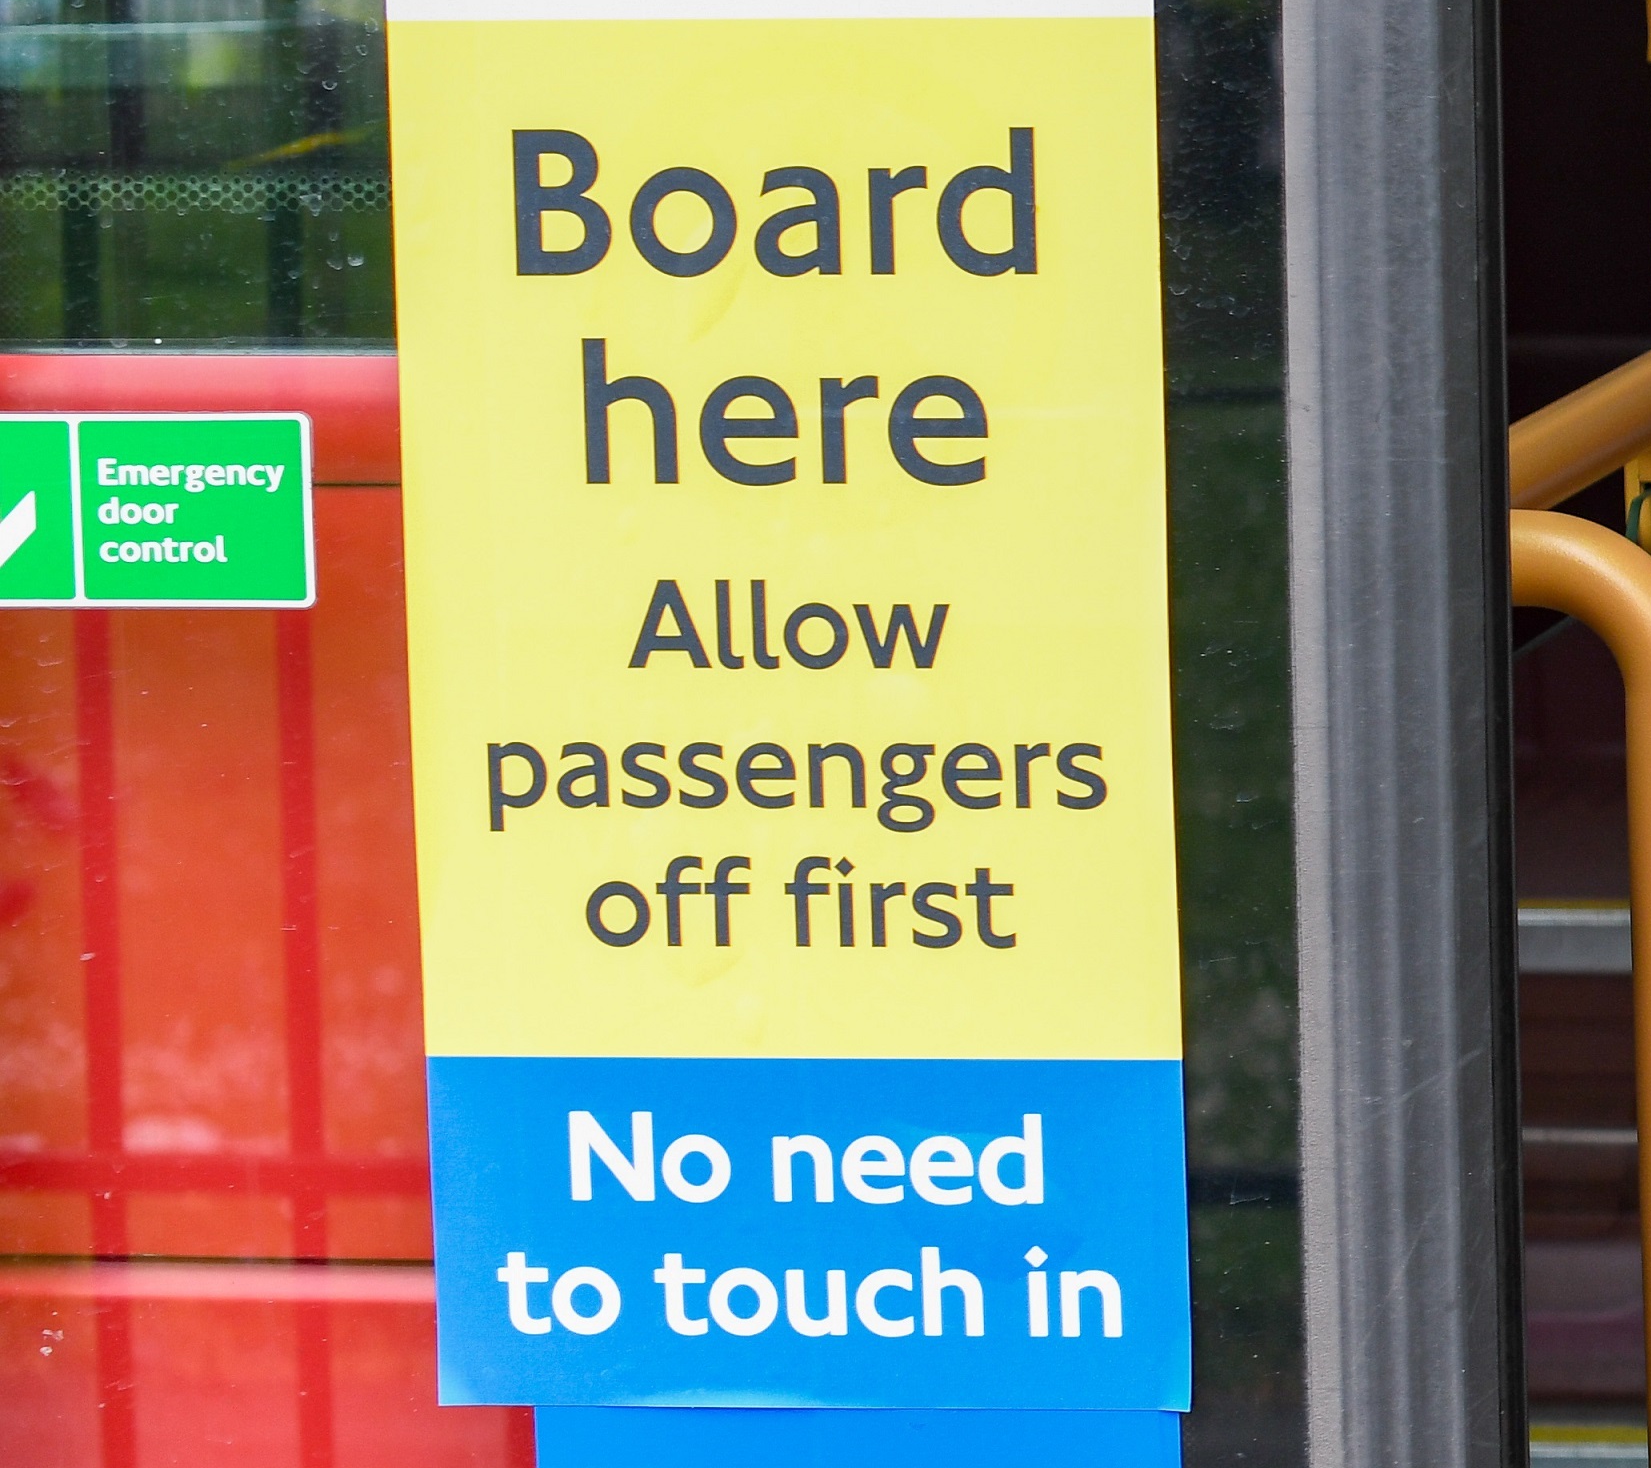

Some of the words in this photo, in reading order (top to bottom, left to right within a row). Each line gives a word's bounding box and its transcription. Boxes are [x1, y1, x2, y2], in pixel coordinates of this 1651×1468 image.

[512, 127, 1037, 277] Board
[582, 338, 988, 486] here
[98, 458, 284, 492] Emergency
[98, 497, 179, 524] door
[100, 535, 227, 562] control
[628, 580, 949, 670] Allow
[488, 742, 1107, 833] passengers
[586, 856, 751, 947] off
[785, 856, 1016, 949] first
[569, 1111, 731, 1203] No
[772, 1114, 1044, 1205] need
[497, 1252, 621, 1335] to
[654, 1247, 984, 1337] touch
[1025, 1246, 1122, 1337] in
